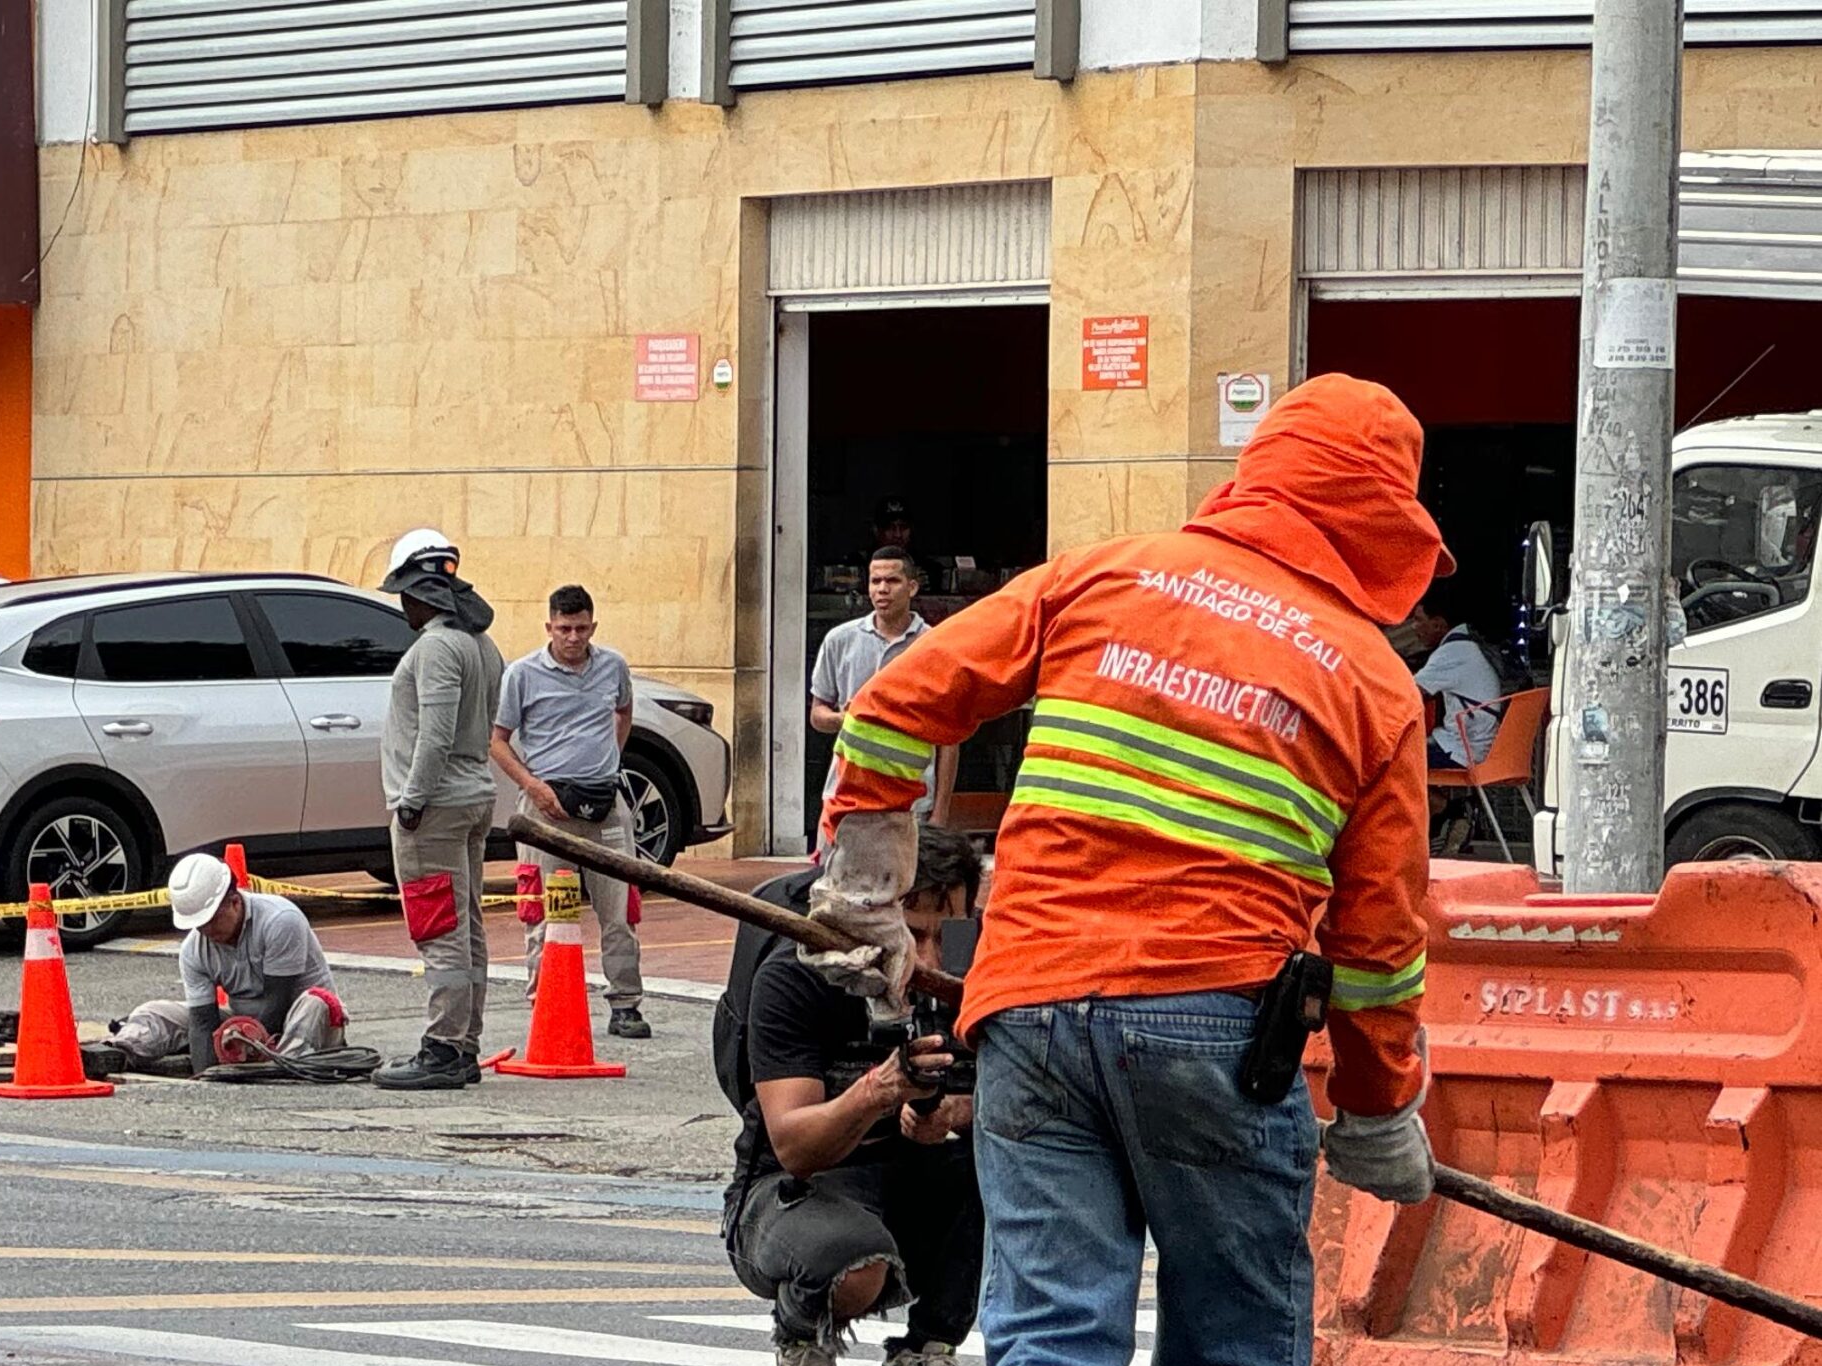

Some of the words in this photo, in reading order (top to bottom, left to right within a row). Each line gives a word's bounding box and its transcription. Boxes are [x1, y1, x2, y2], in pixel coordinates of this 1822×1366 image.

[1136, 569, 1252, 622] SANTIAGO
[1257, 612, 1292, 639] DE
[1293, 631, 1344, 672] CALI
[1191, 568, 1283, 612] ALCALDÍA
[1285, 606, 1314, 627] DE
[1096, 642, 1302, 743] INFRAESTRUCTURA
[1680, 677, 1724, 716] 386
[1480, 979, 1622, 1020] SIPLAST
